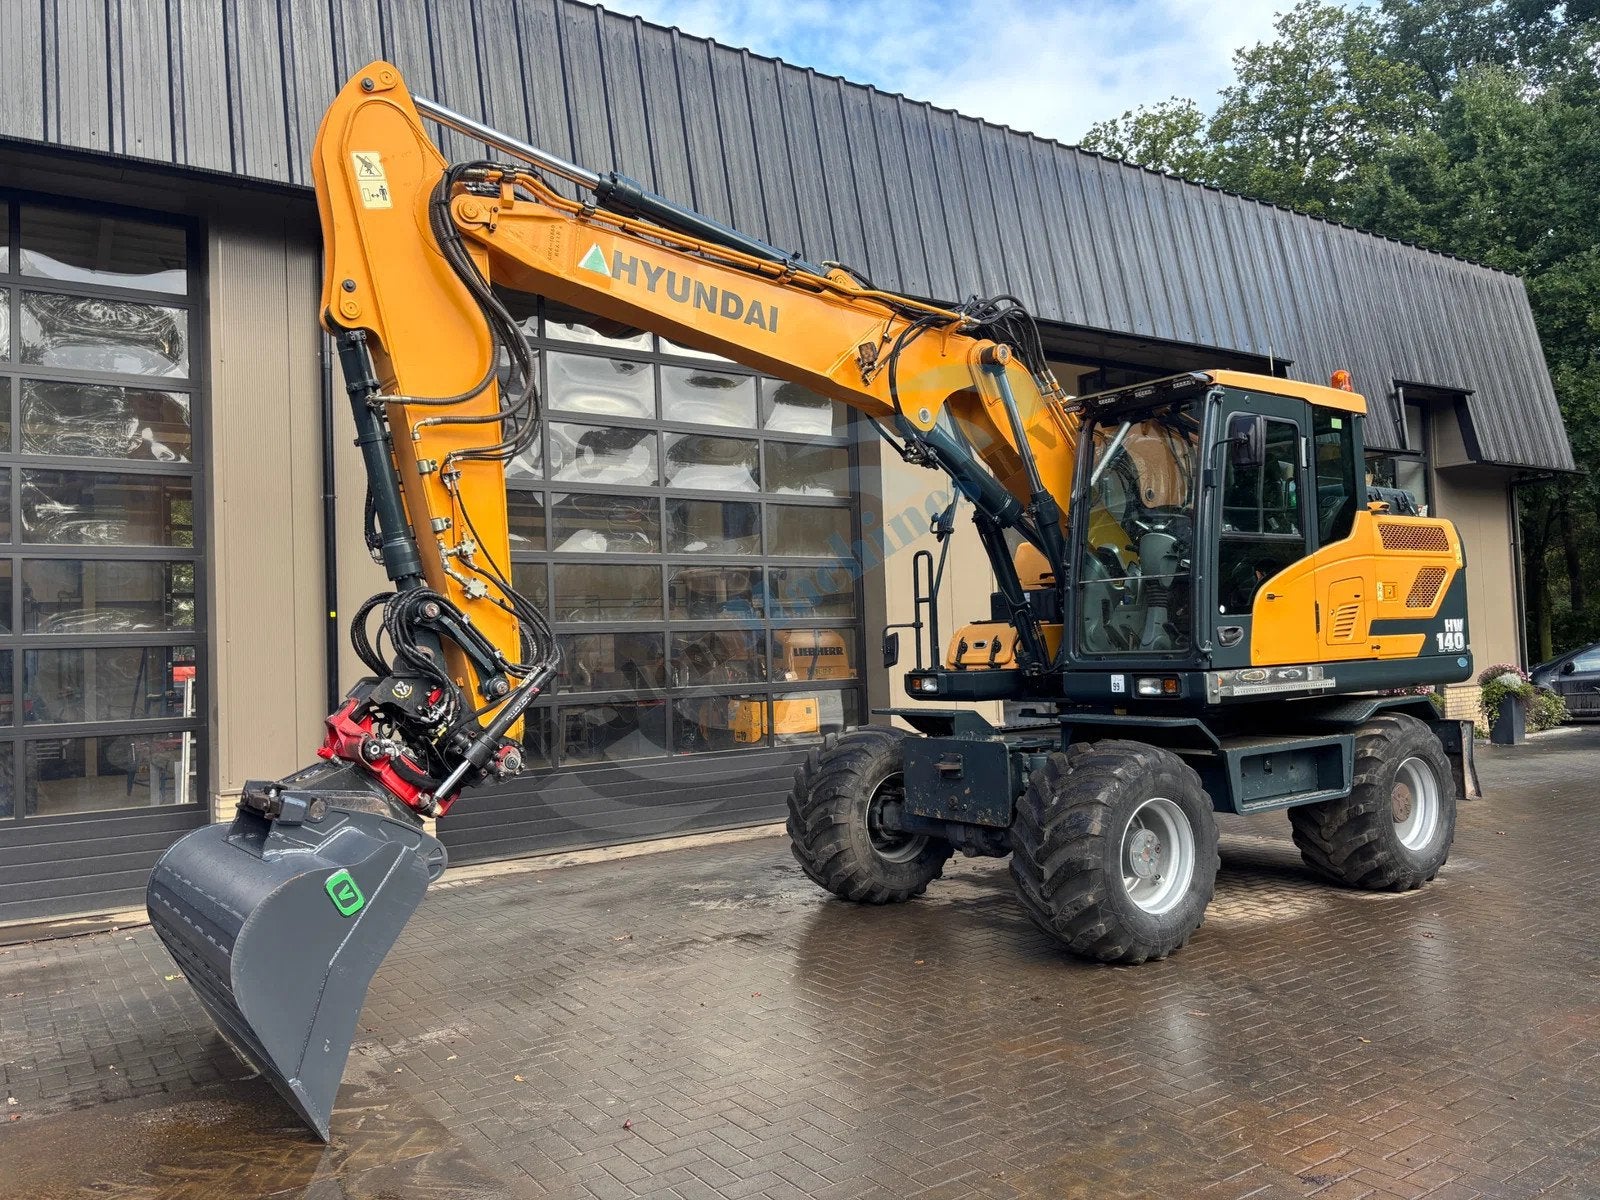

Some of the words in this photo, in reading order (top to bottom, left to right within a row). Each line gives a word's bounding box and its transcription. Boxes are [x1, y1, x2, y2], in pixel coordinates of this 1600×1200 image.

[611, 250, 779, 333] HYUNDAI
[1444, 618, 1464, 632] HW
[1436, 632, 1465, 652] 140
[793, 647, 844, 657] LIEBHERR
